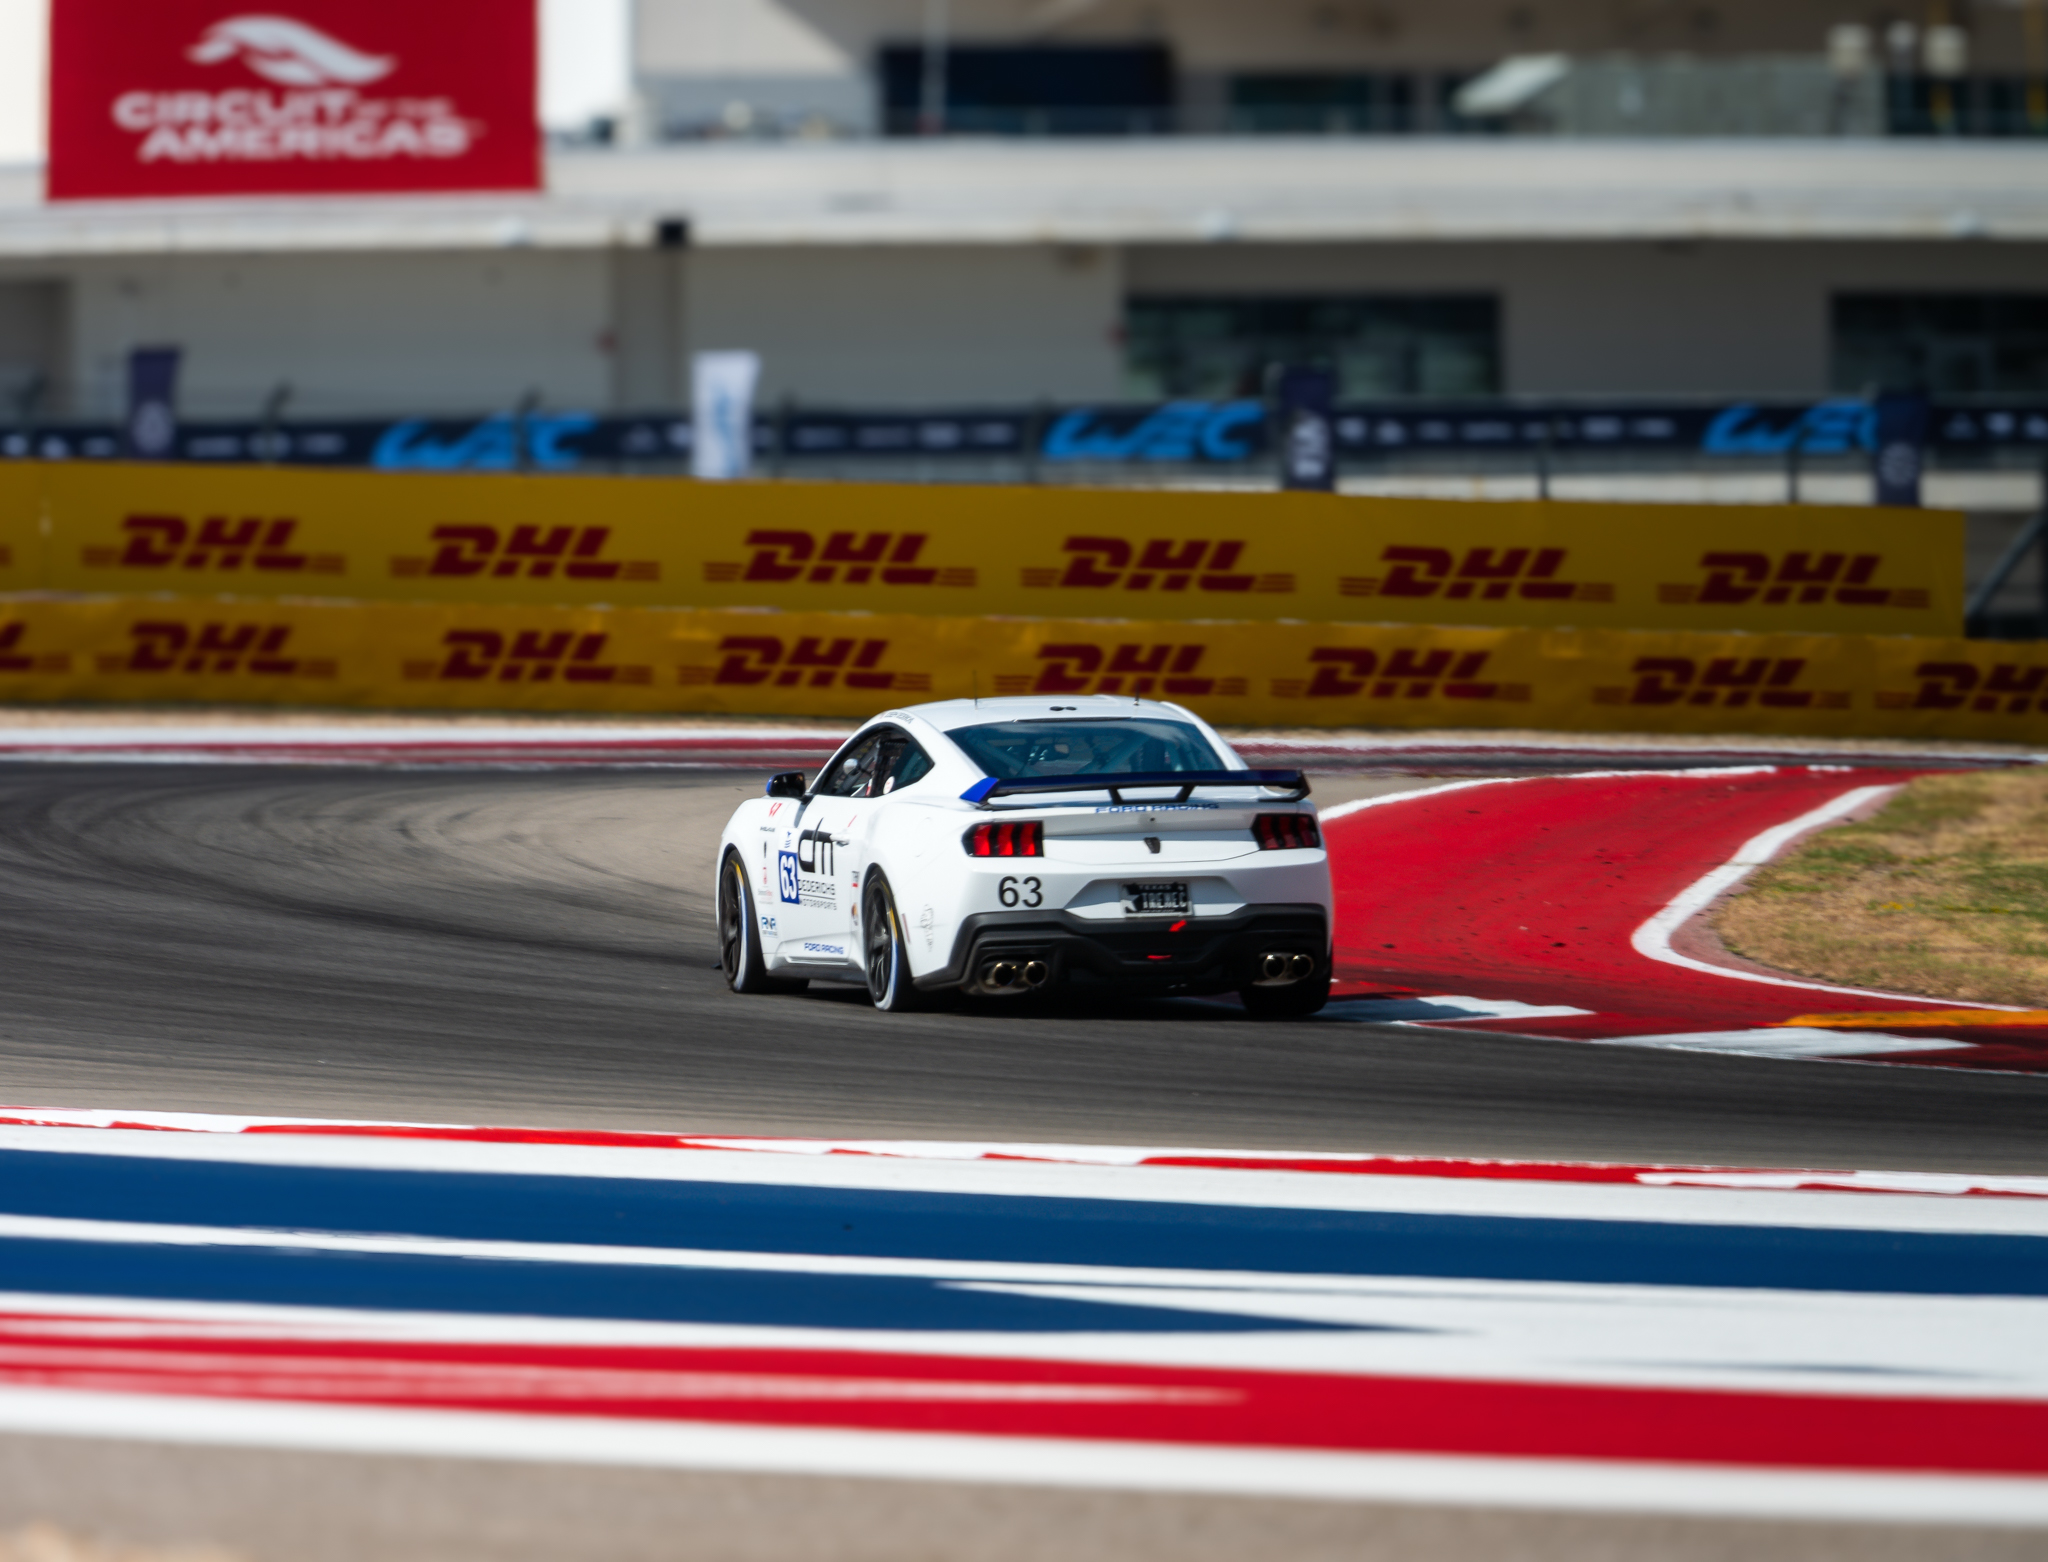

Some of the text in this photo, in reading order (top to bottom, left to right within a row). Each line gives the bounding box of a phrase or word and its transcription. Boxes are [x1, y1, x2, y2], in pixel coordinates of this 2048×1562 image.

[112, 89, 355, 131] CIRCUIT
[138, 120, 471, 163] AMERICAS
[1045, 402, 1264, 460] WEC
[121, 516, 307, 571] DHL
[429, 525, 621, 580] DHL
[744, 530, 938, 585] DHL
[1060, 537, 1256, 592] DHL
[1380, 546, 1577, 601] DHL
[1696, 552, 1892, 608] DHL
[128, 622, 299, 675] DHL
[440, 631, 617, 683] DHL
[714, 636, 896, 690] DHL
[1034, 644, 1215, 696] DHL
[1306, 648, 1498, 700] DHL
[1629, 657, 1807, 709] DHL
[1913, 662, 2048, 714] DH
[780, 853, 797, 900] 63
[999, 876, 1042, 908] 63
[804, 942, 821, 952] FORD
